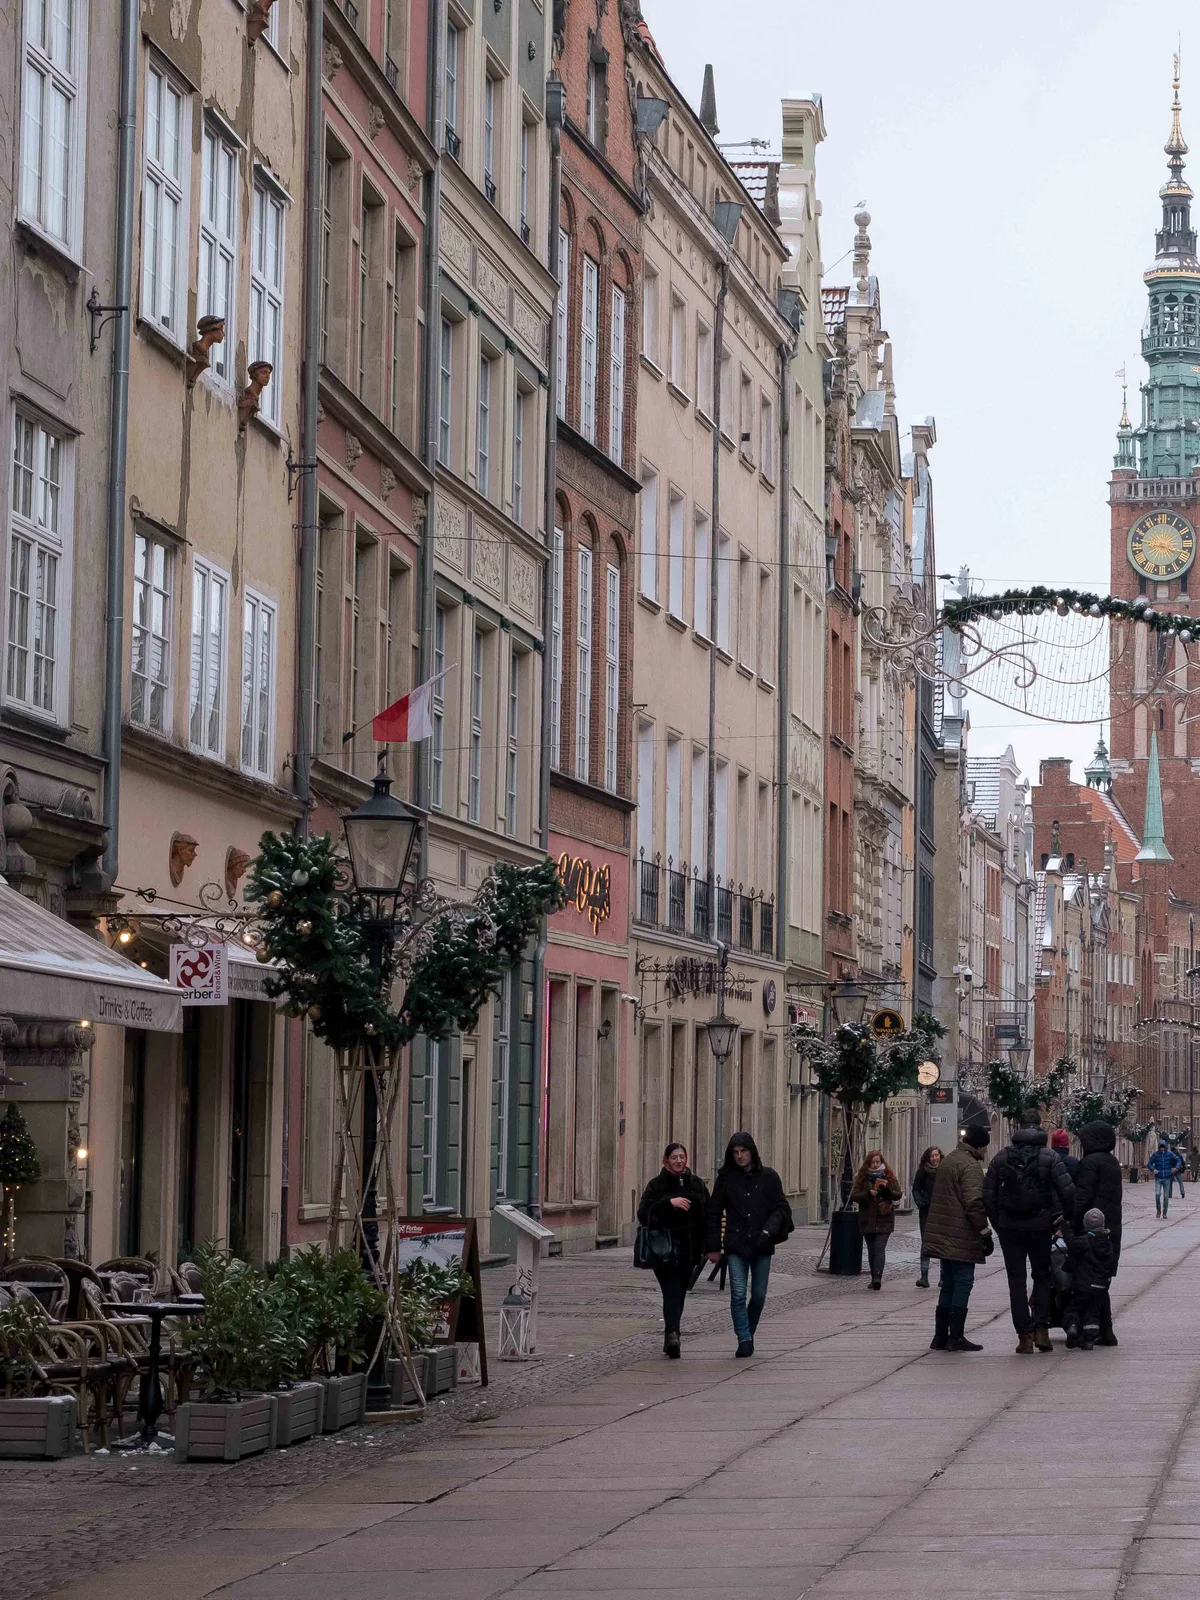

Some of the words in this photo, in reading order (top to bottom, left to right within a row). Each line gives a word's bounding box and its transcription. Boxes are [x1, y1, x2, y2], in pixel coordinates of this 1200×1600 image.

[213, 949, 221, 999] Bread&Wine
[182, 987, 214, 1000] erber
[99, 995, 122, 1019] Drinks
[124, 1000, 130, 1021] &
[131, 1001, 152, 1022] Coffee
[406, 1224, 424, 1232] Ferber
